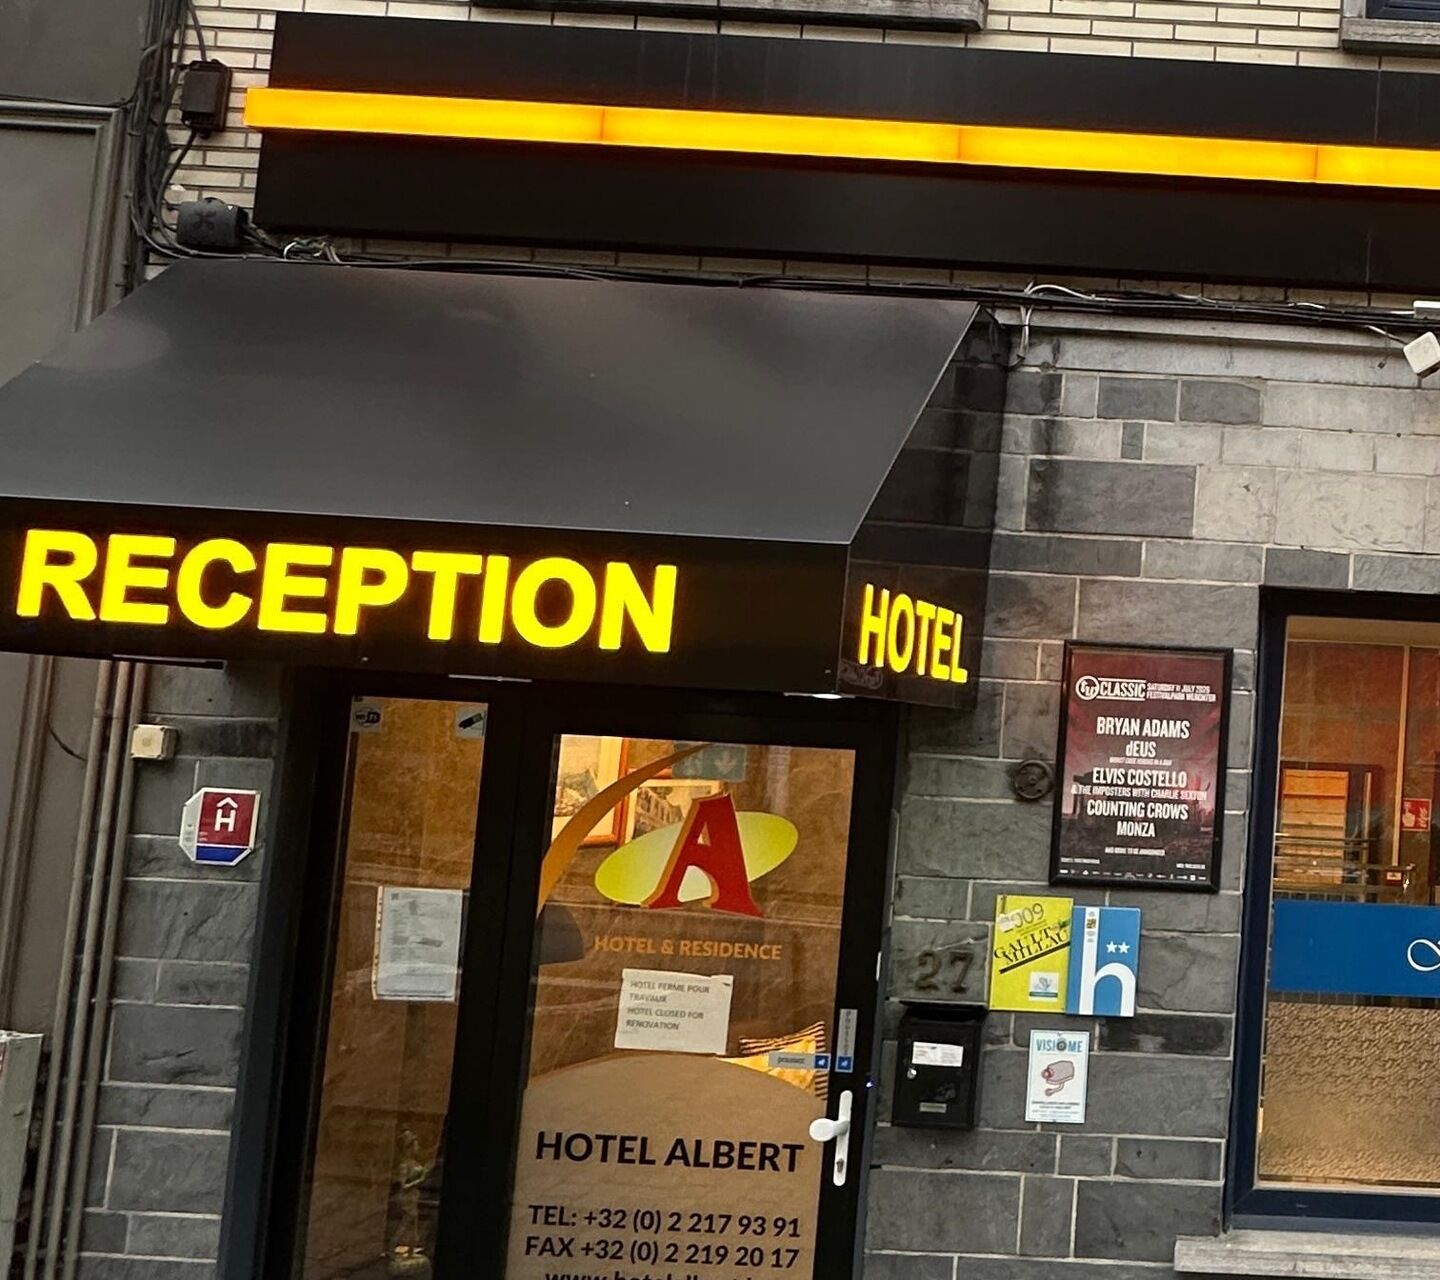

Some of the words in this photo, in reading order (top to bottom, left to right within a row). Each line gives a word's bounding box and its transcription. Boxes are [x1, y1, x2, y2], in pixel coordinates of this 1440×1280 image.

[15, 528, 678, 653] RECEPTION
[858, 583, 968, 683] HOTEL
[1100, 681, 1146, 698] CLASSIC
[1096, 716, 1140, 736] BRYAN
[1142, 719, 1190, 739] ADAMS
[1125, 740, 1156, 758] dEUS
[1092, 767, 1125, 785] ELVIS
[1127, 769, 1187, 788] COSTELLO
[1078, 785, 1092, 796] THE
[1092, 786, 1131, 798] IMPOSTERS
[1150, 789, 1179, 800] CHARLIE
[1086, 800, 1145, 818] COUNTING
[1147, 802, 1189, 820] CROWS
[1116, 821, 1156, 837] MONZA
[639, 792, 765, 919] A
[594, 935, 656, 955] HOTEL
[660, 939, 675, 956] &
[679, 940, 783, 961] RESIDENCE
[914, 950, 974, 994] 27
[630, 980, 656, 991] HOTEL
[687, 983, 711, 995] POUR
[627, 1006, 653, 1018] HOTEL
[655, 1008, 687, 1019] CLOSED
[687, 1010, 705, 1020] FOR
[626, 1019, 680, 1031] RENOVATION
[536, 1131, 656, 1165] HOTEL
[663, 1138, 805, 1172] ALBERT
[528, 1204, 577, 1227] TEL:
[584, 1208, 627, 1229] +32
[633, 1209, 662, 1234] (0)
[668, 1212, 682, 1232] 2
[687, 1213, 732, 1234] 217
[738, 1215, 766, 1236] 93
[773, 1217, 801, 1237] 91
[524, 1236, 574, 1258] FAX
[580, 1239, 624, 1260] +32
[630, 1240, 659, 1265] (0)
[665, 1243, 679, 1263] 2
[685, 1244, 729, 1266] 219
[734, 1247, 764, 1268] 20
[771, 1249, 800, 1269] 17
